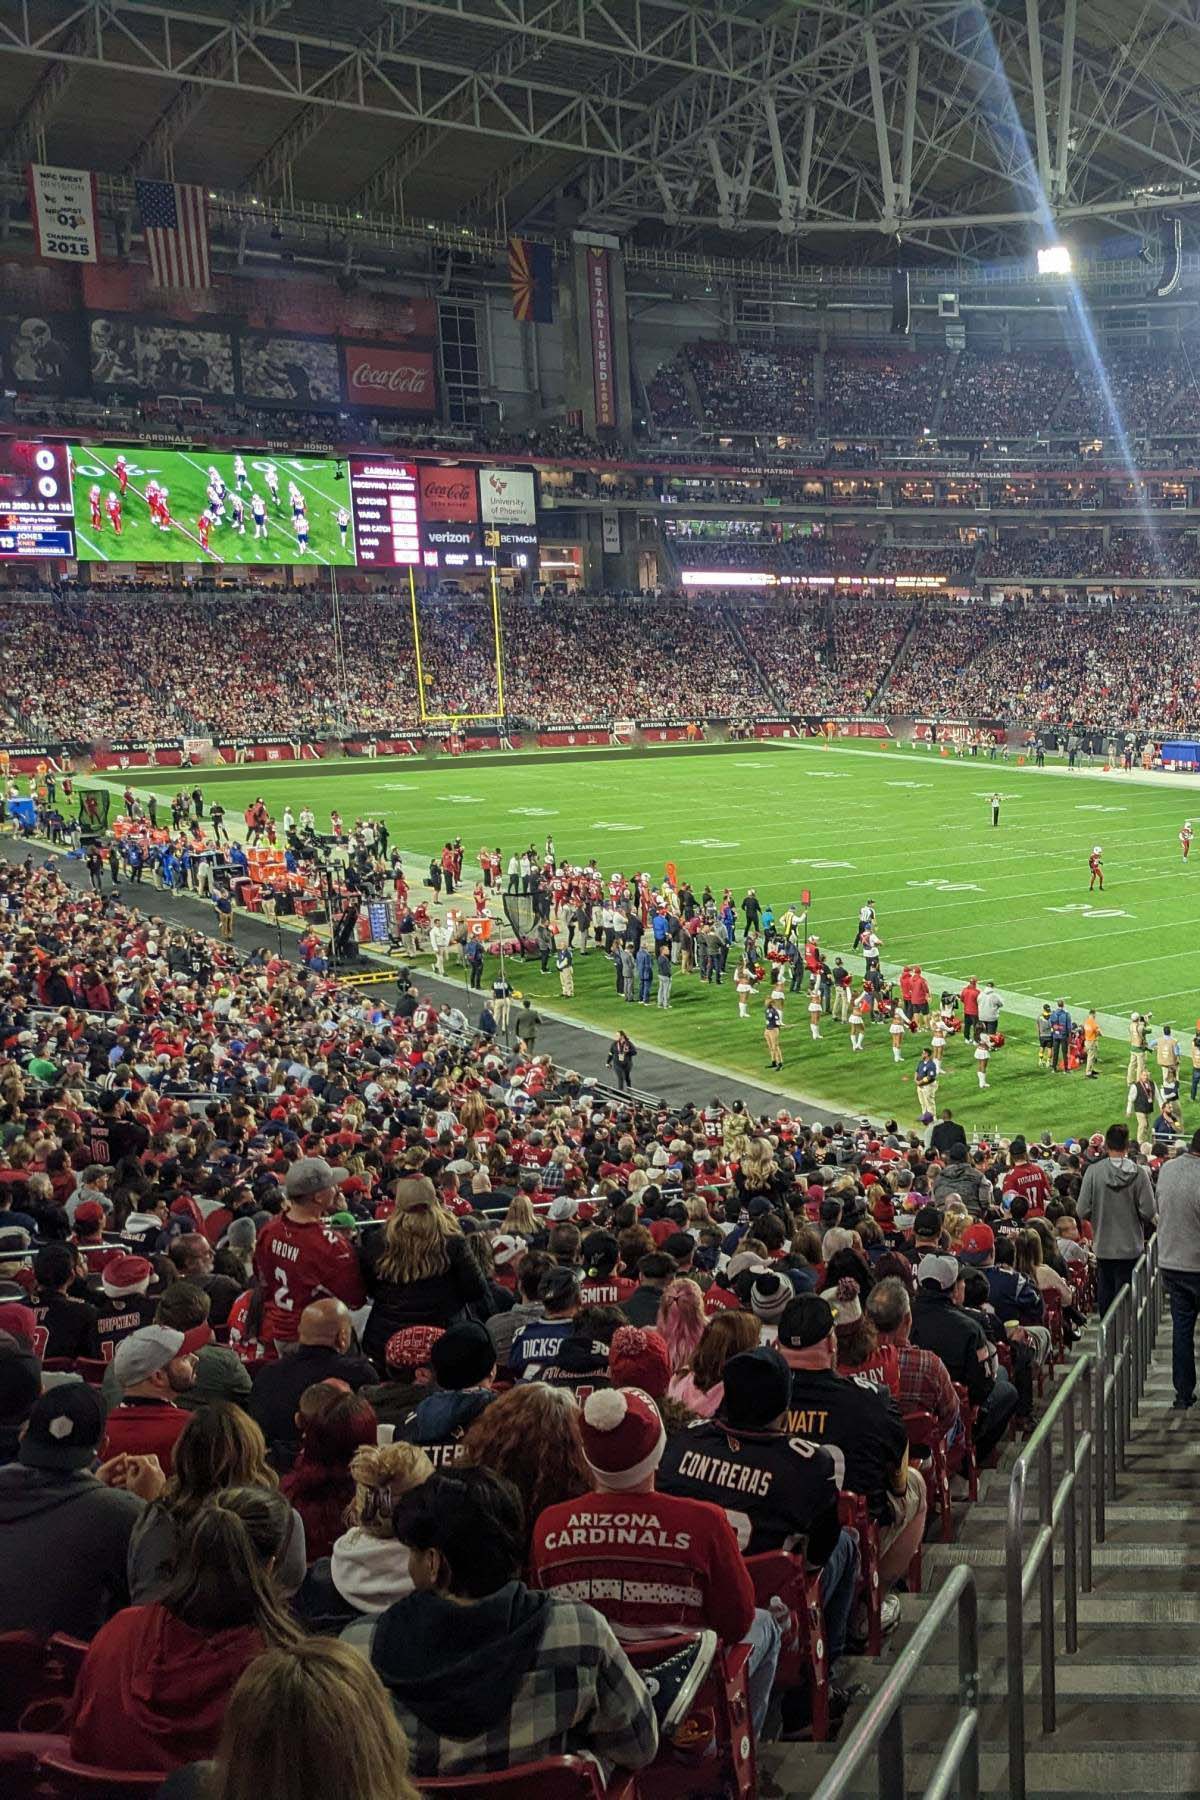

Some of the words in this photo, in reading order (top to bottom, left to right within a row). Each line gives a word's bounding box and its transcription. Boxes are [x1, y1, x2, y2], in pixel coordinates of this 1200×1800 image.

[47, 240, 90, 256] 2015
[594, 266, 608, 381] ESTABLISHED
[352, 362, 430, 392] Coca-Cola
[139, 433, 193, 443] CARDINALS
[267, 441, 289, 449] RING
[303, 443, 334, 451] HONOR
[36, 449, 55, 471] 0
[364, 467, 406, 476] CARDINALS
[741, 466, 763, 474] OLLIE
[764, 468, 794, 476] MATSON
[38, 476, 58, 498] 0
[424, 482, 470, 498] Coca-Cola
[48, 503, 60, 511] ON
[357, 498, 387, 506] CATCHES
[491, 498, 525, 508] University
[491, 507, 499, 515] of
[500, 507, 527, 515] Phoenix
[428, 531, 470, 544] verizon
[501, 536, 537, 544] BETMGM
[8, 747, 47, 756] RDINALS
[906, 878, 986, 893] 30
[1043, 902, 1137, 920] 20
[472, 922, 483, 934] G
[271, 1239, 300, 1263] BROWN
[274, 1266, 294, 1312] 2
[580, 1286, 618, 1304] SMITH
[98, 1311, 141, 1334] HOPKINS
[678, 1451, 773, 1498] CONTRERAS
[567, 1513, 662, 1529] ARIZONA
[544, 1528, 692, 1551] CARDINALS
